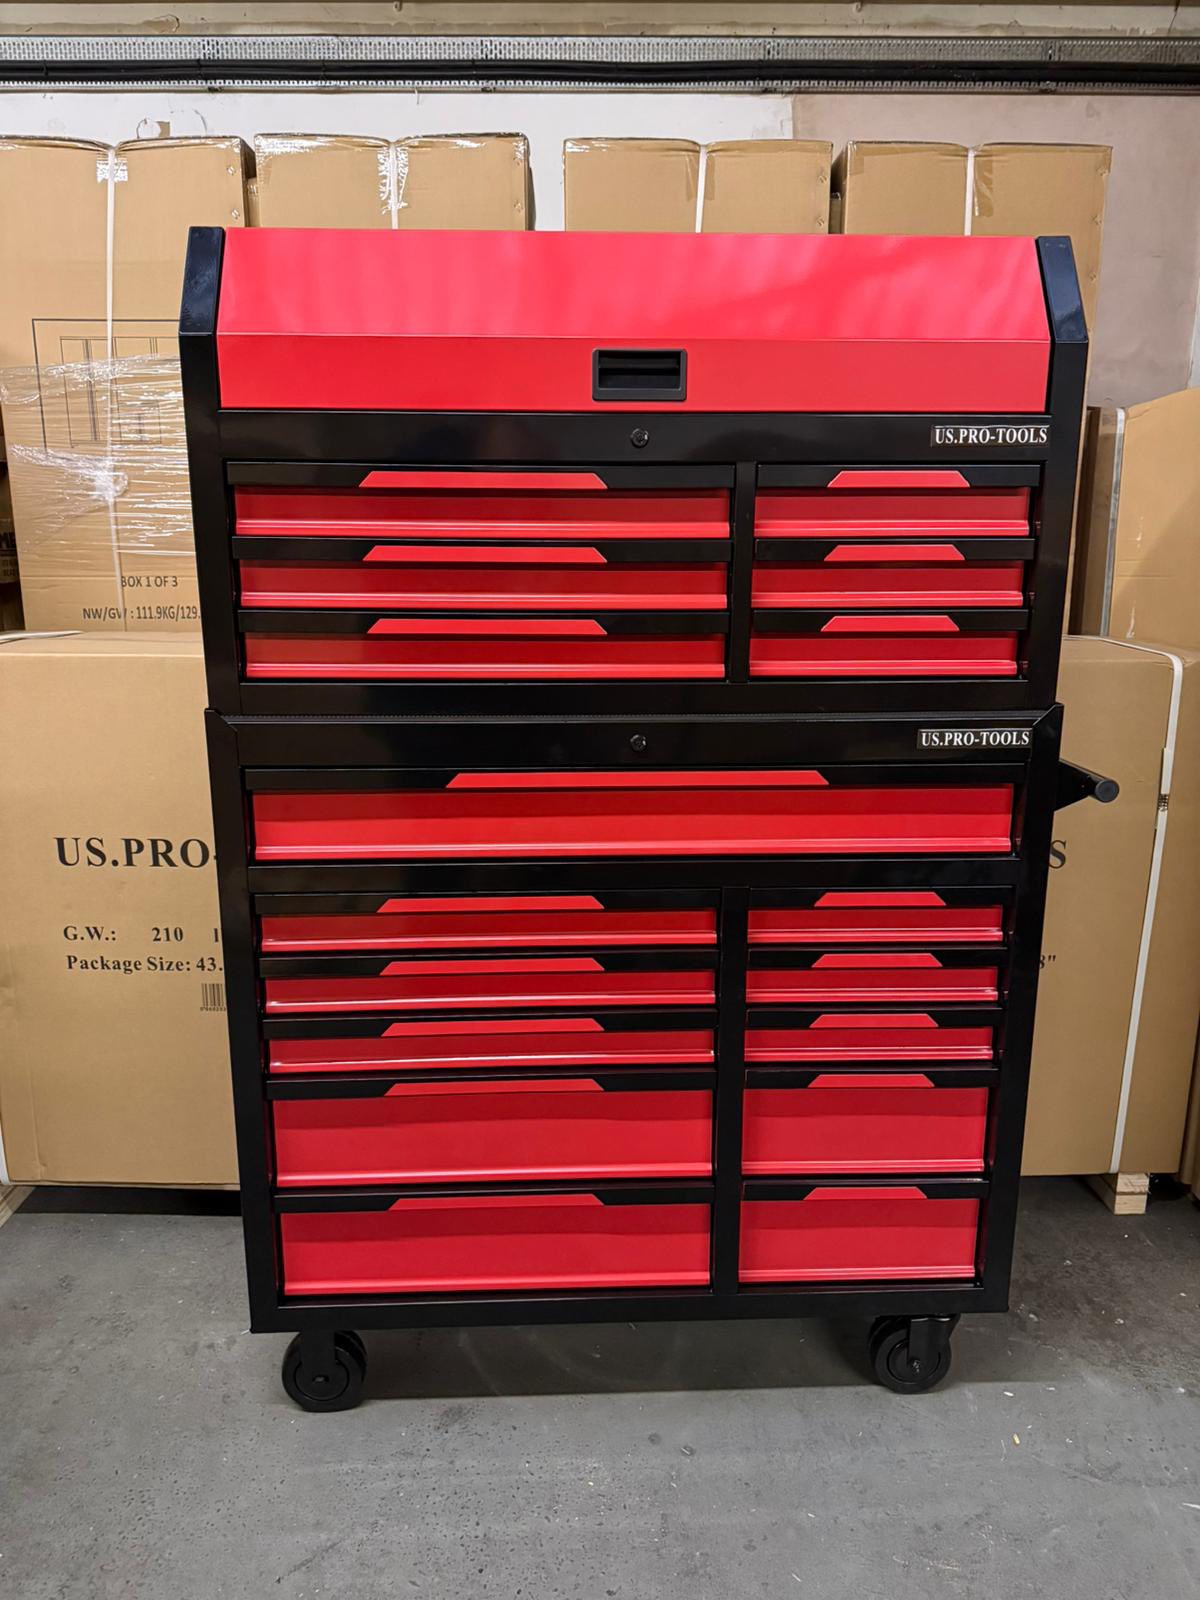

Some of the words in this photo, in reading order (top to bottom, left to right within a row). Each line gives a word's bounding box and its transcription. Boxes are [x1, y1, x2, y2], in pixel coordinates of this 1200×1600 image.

[935, 428, 1048, 444] US.PRO-TOOLS
[121, 576, 143, 587] BOX
[145, 576, 151, 587] 1
[154, 576, 169, 587] OF
[171, 576, 178, 587] 3
[921, 731, 1030, 747] US.PRO-TOOLS
[54, 836, 217, 868] US.PRO
[63, 926, 117, 942] G.W.:
[152, 927, 184, 942] 210
[66, 955, 142, 975] Package
[147, 956, 191, 972] Size:
[195, 957, 224, 972] 43.
